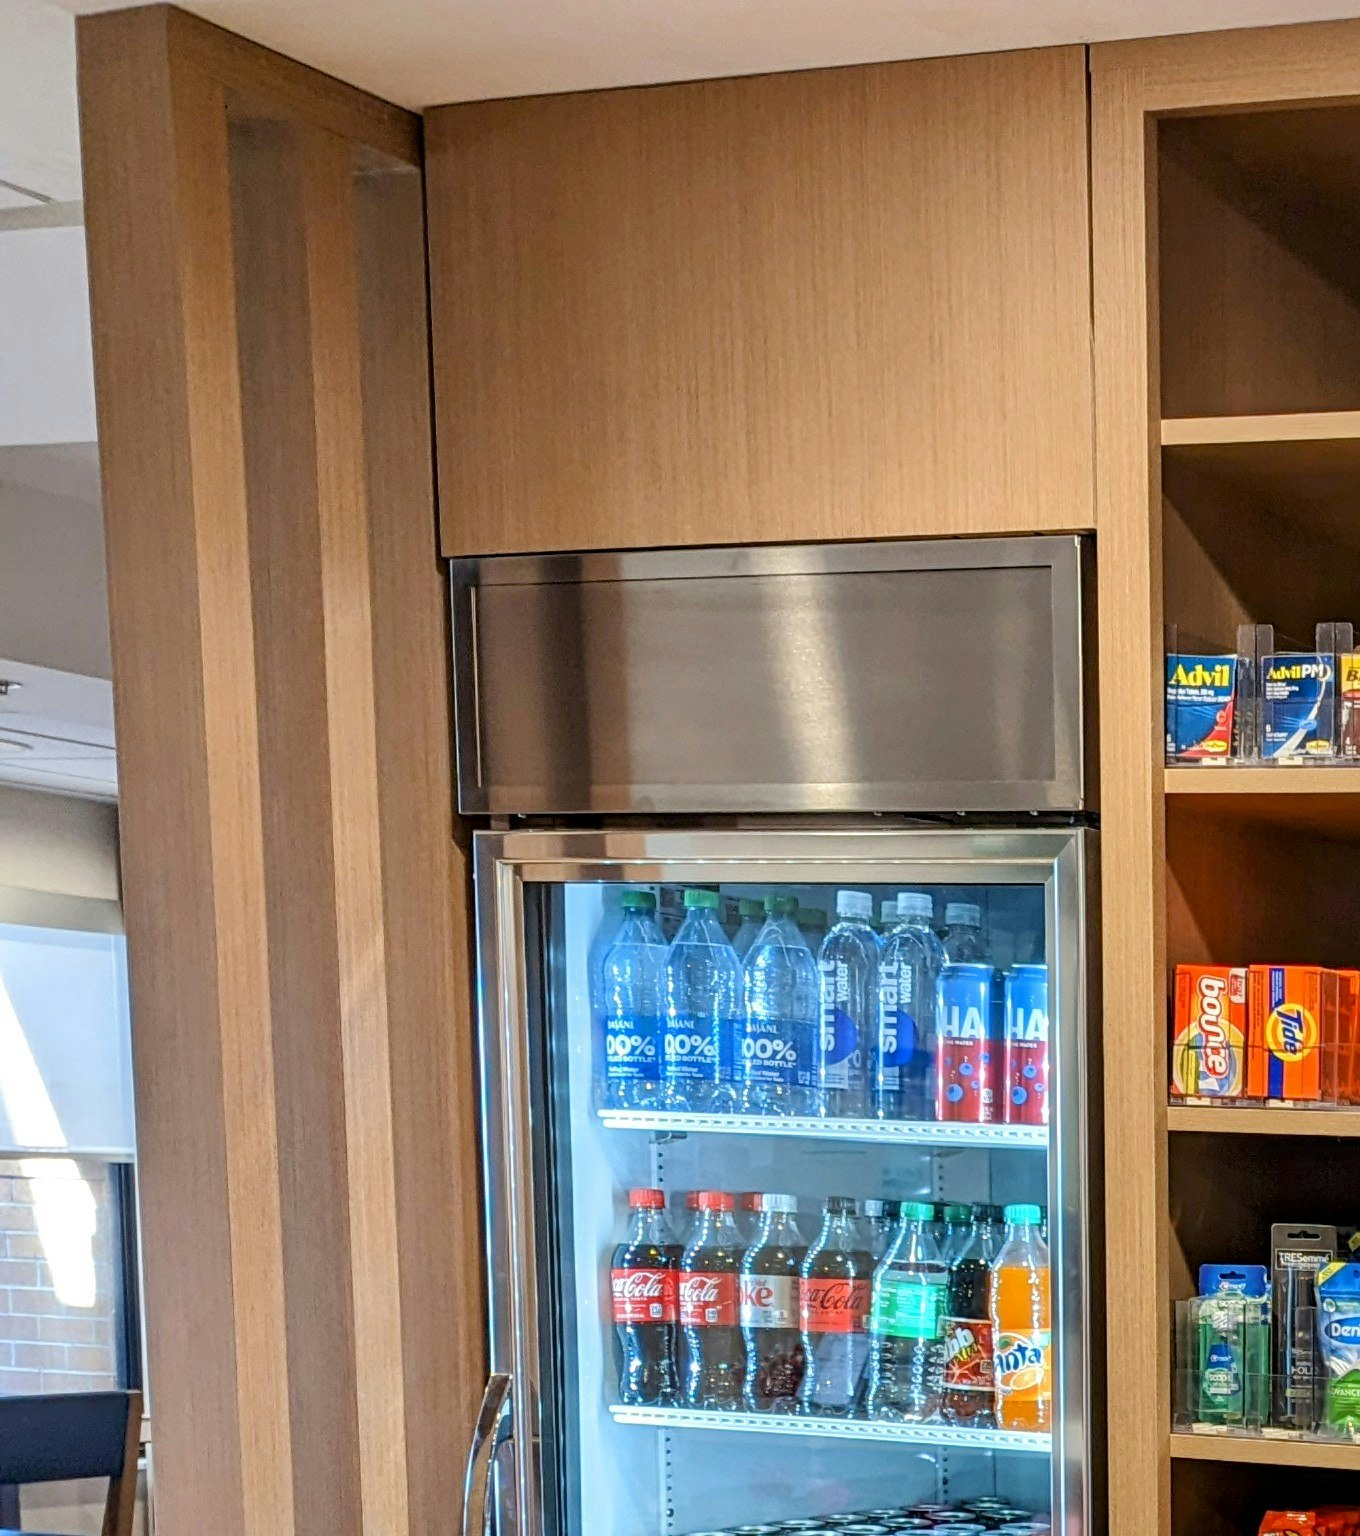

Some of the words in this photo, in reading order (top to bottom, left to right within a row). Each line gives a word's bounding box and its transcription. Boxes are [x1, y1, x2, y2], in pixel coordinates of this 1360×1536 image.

[1172, 663, 1230, 687] Advil
[1266, 665, 1301, 680] Advil
[1200, 976, 1228, 1078] bounce
[1276, 1008, 1304, 1056] Tide
